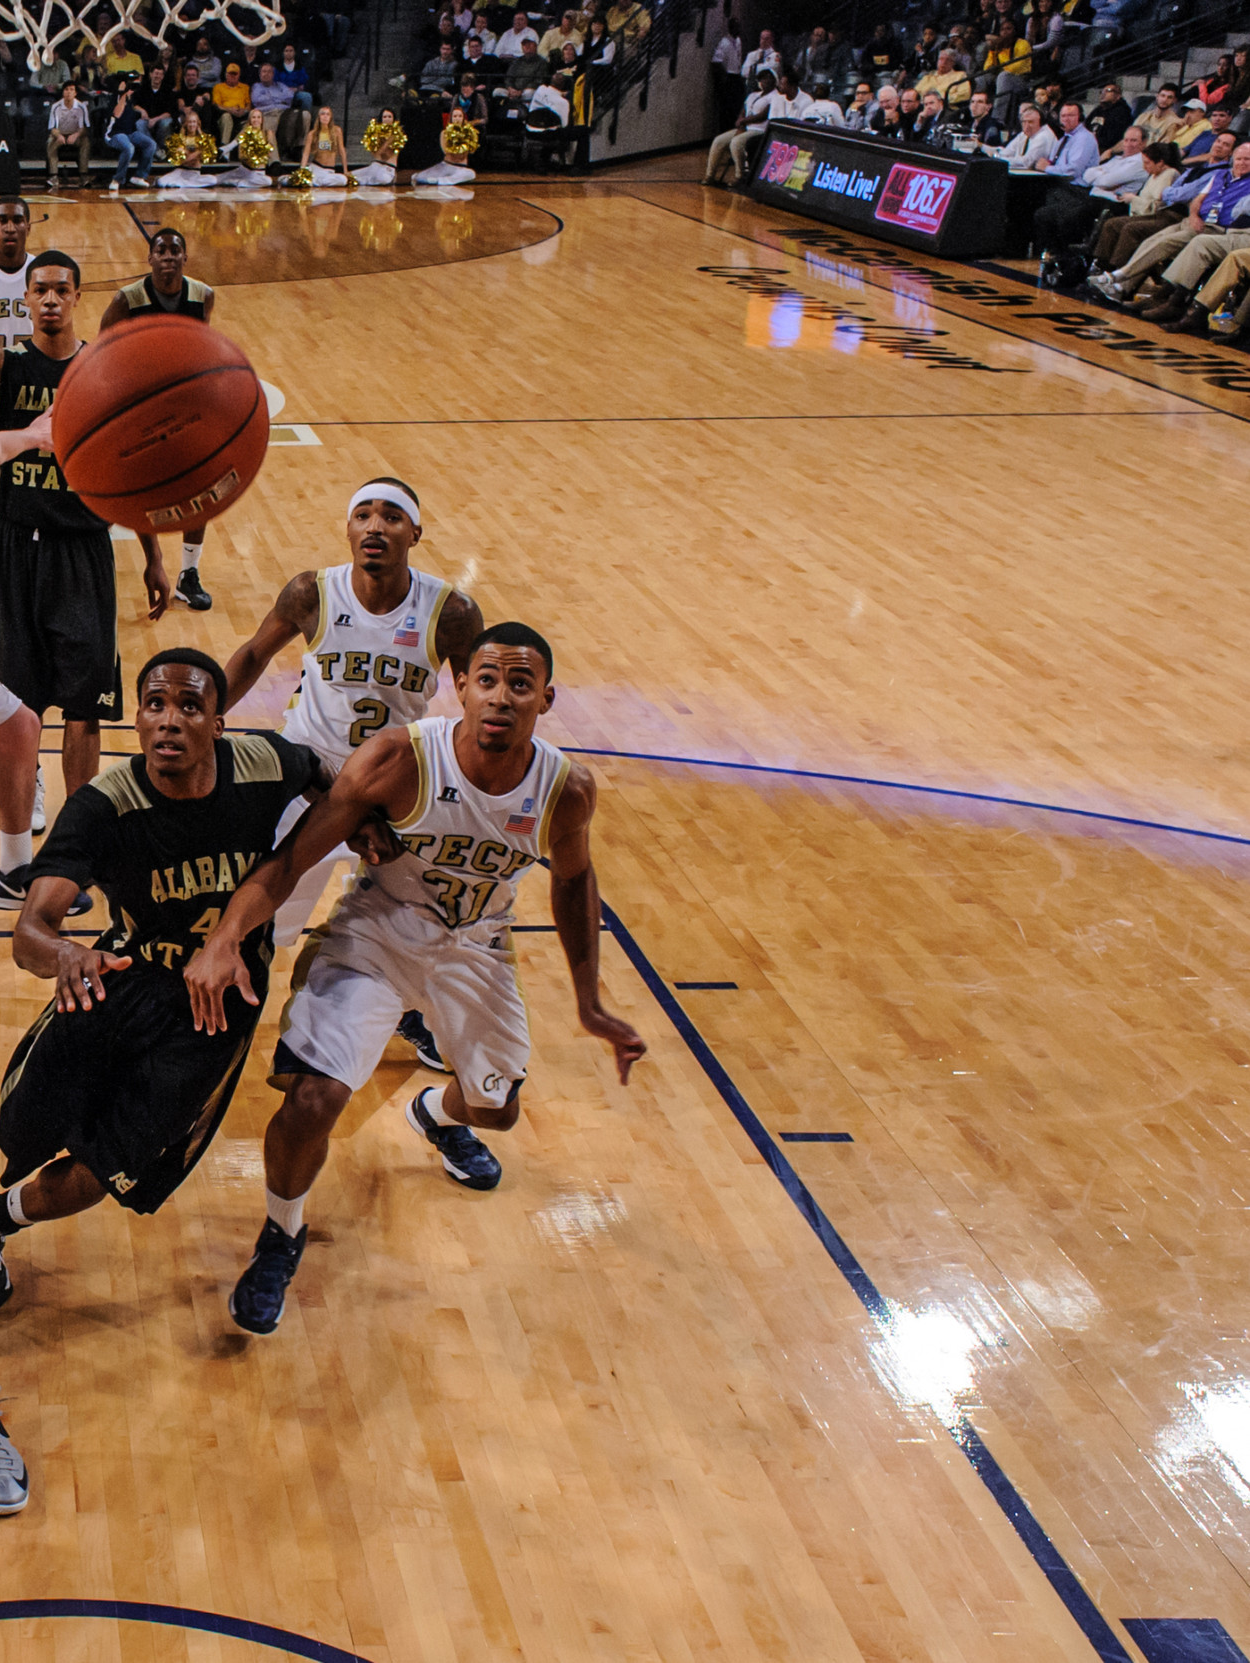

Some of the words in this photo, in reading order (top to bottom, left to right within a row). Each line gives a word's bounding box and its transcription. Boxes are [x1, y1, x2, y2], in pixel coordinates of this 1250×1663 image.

[759, 140, 799, 184] 790
[812, 161, 850, 194] Listen
[845, 169, 881, 202] Live!
[902, 173, 953, 216] 106.7
[767, 229, 1038, 307] McCamish
[1010, 312, 1250, 393] Pavilio
[316, 651, 430, 694] TECH
[348, 698, 390, 747] 2
[401, 834, 537, 878] TECH
[422, 868, 499, 931] 31
[190, 907, 221, 942] 4
